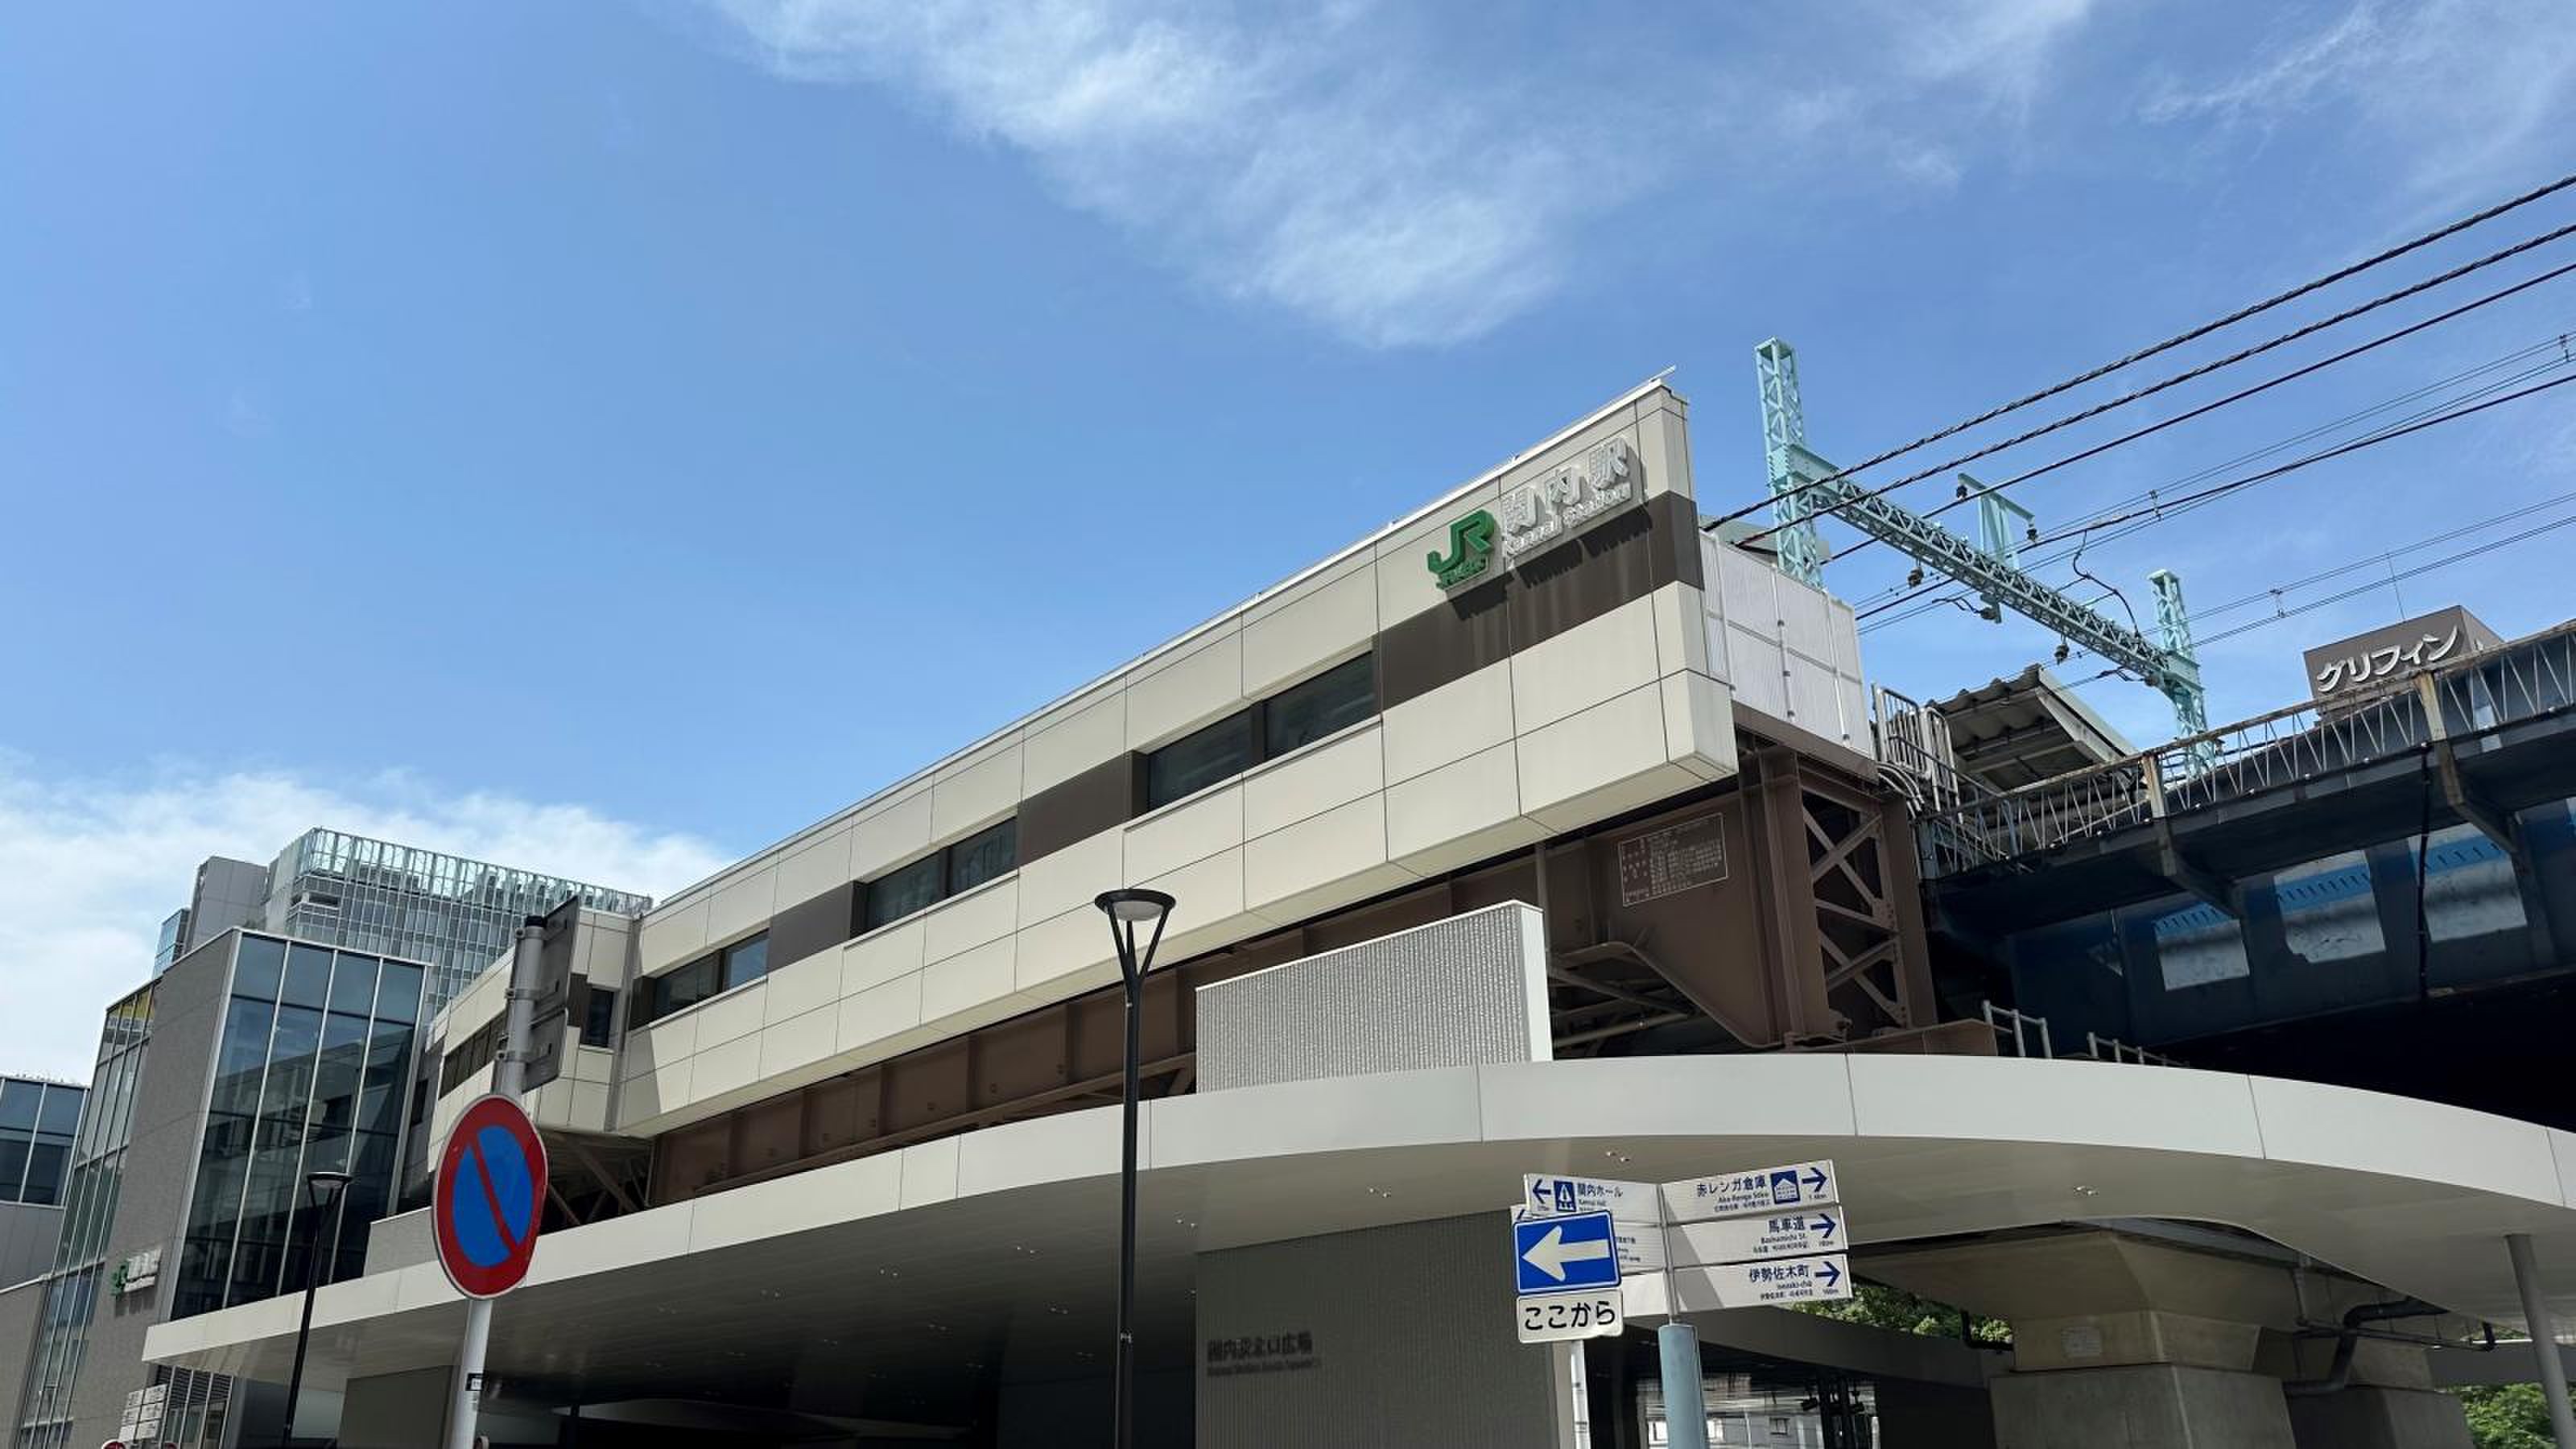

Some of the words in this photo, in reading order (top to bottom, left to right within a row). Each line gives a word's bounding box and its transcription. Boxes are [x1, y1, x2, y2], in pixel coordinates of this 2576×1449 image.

[1502, 438, 1630, 535] 関内駅
[1426, 509, 1495, 575] JR
[2317, 625, 2458, 692] グリフィン
[1697, 1174, 1767, 1198] 赤レンガ倉庫
[1769, 1214, 1805, 1233] 馬車道
[1749, 1265, 1809, 1282] 伊勢佐木町
[1525, 1301, 1616, 1331] ここから
